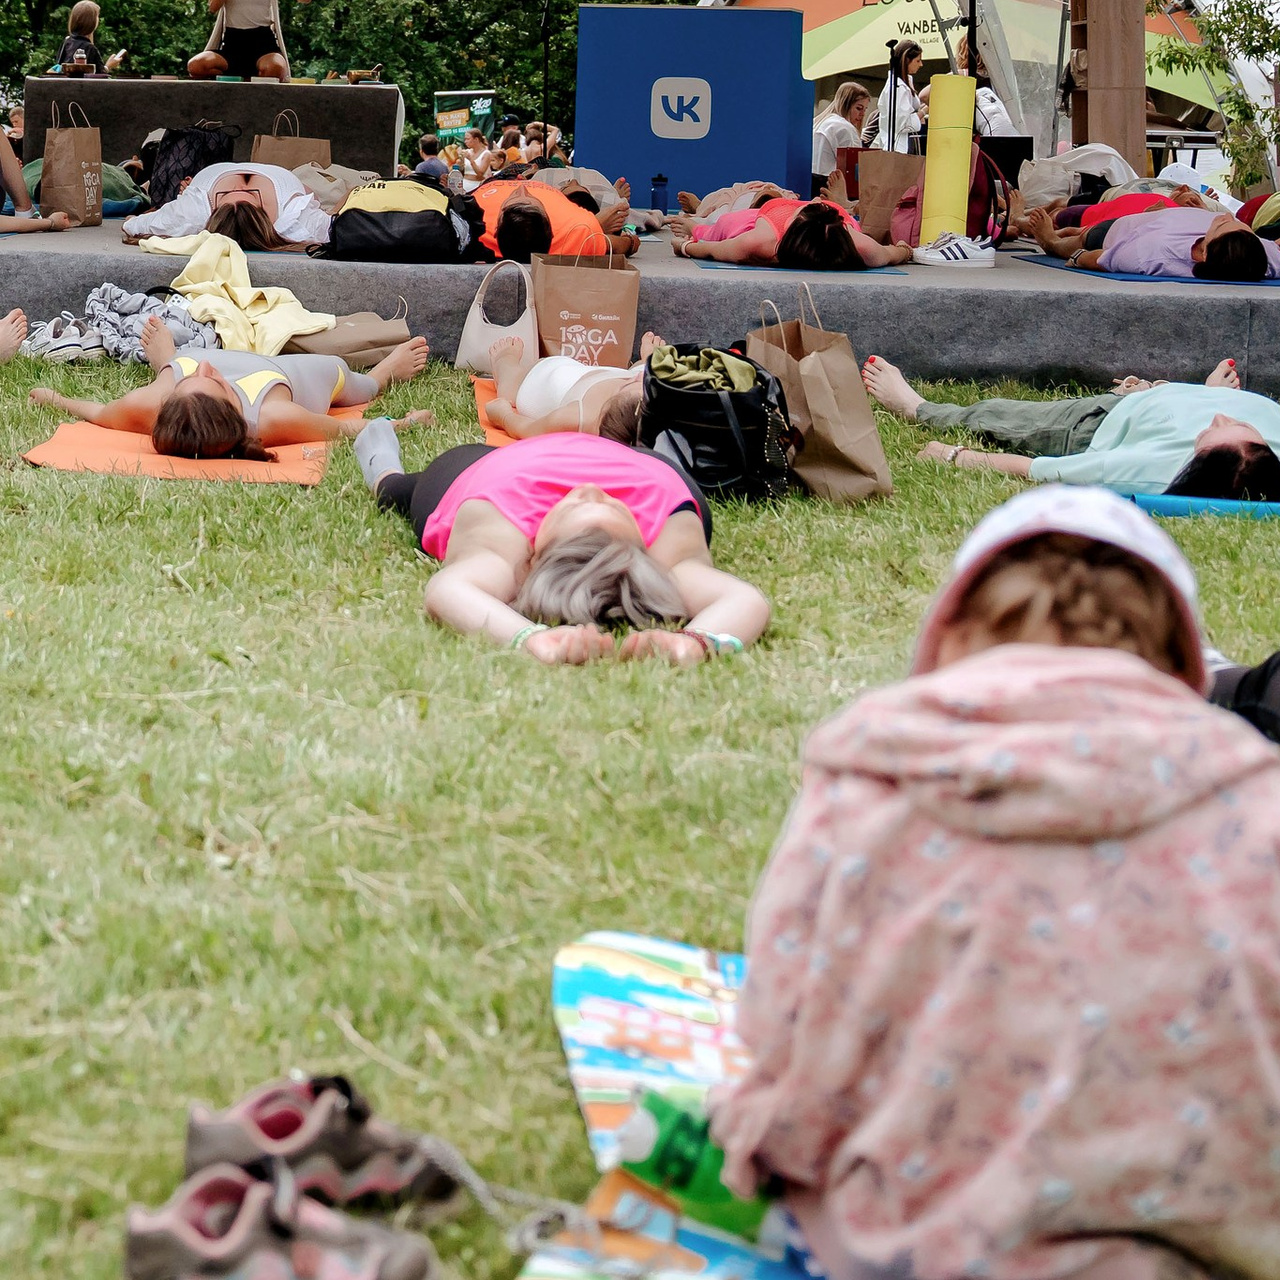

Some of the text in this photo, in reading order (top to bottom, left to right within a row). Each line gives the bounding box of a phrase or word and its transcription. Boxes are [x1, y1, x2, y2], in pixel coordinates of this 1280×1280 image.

[896, 19, 960, 37] VANBE
[661, 95, 701, 123] VK
[560, 343, 604, 361] DAY
